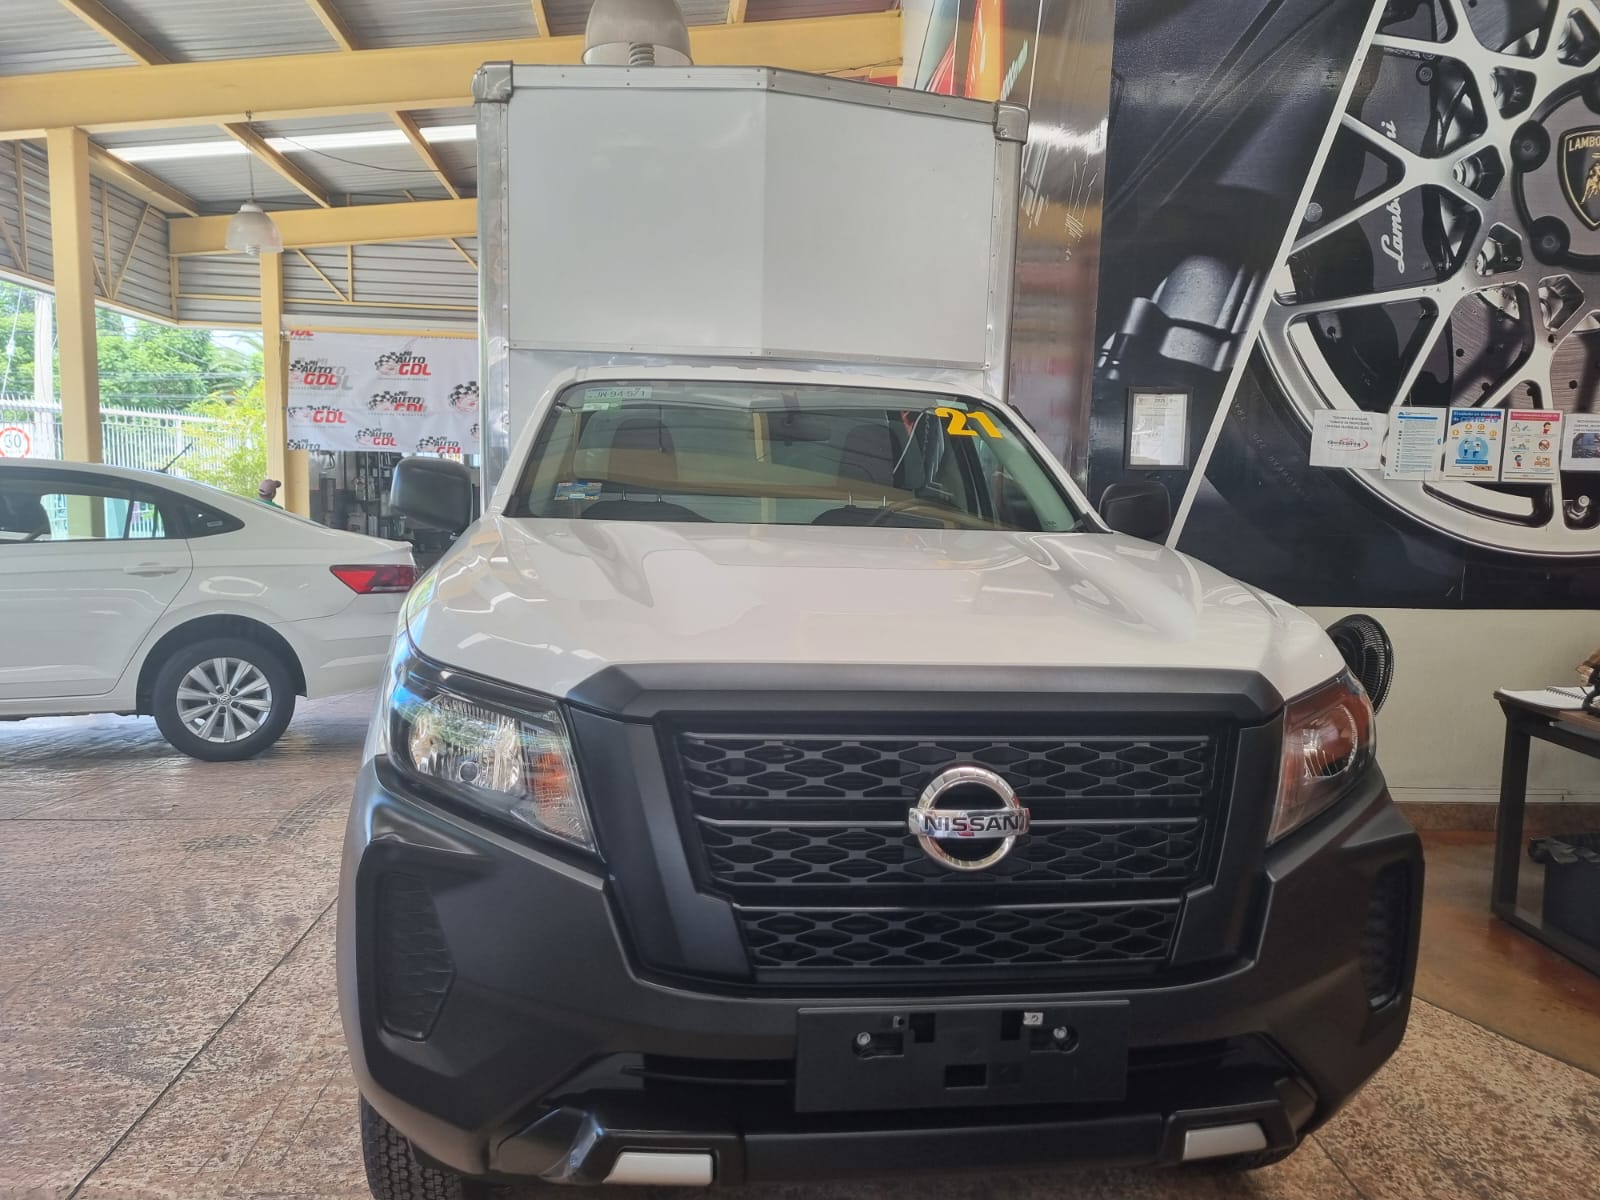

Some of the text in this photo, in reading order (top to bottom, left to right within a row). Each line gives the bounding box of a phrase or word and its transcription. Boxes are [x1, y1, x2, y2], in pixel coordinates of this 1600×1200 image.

[395, 356, 426, 364] AUTO
[301, 365, 333, 374] AUTO
[399, 363, 432, 376] GDL
[303, 371, 337, 385] GDL
[390, 396, 421, 404] AUTO
[312, 410, 348, 424] GDL
[934, 407, 1003, 438] 21
[373, 437, 397, 447] GDL
[924, 815, 1019, 832] NISSAN
